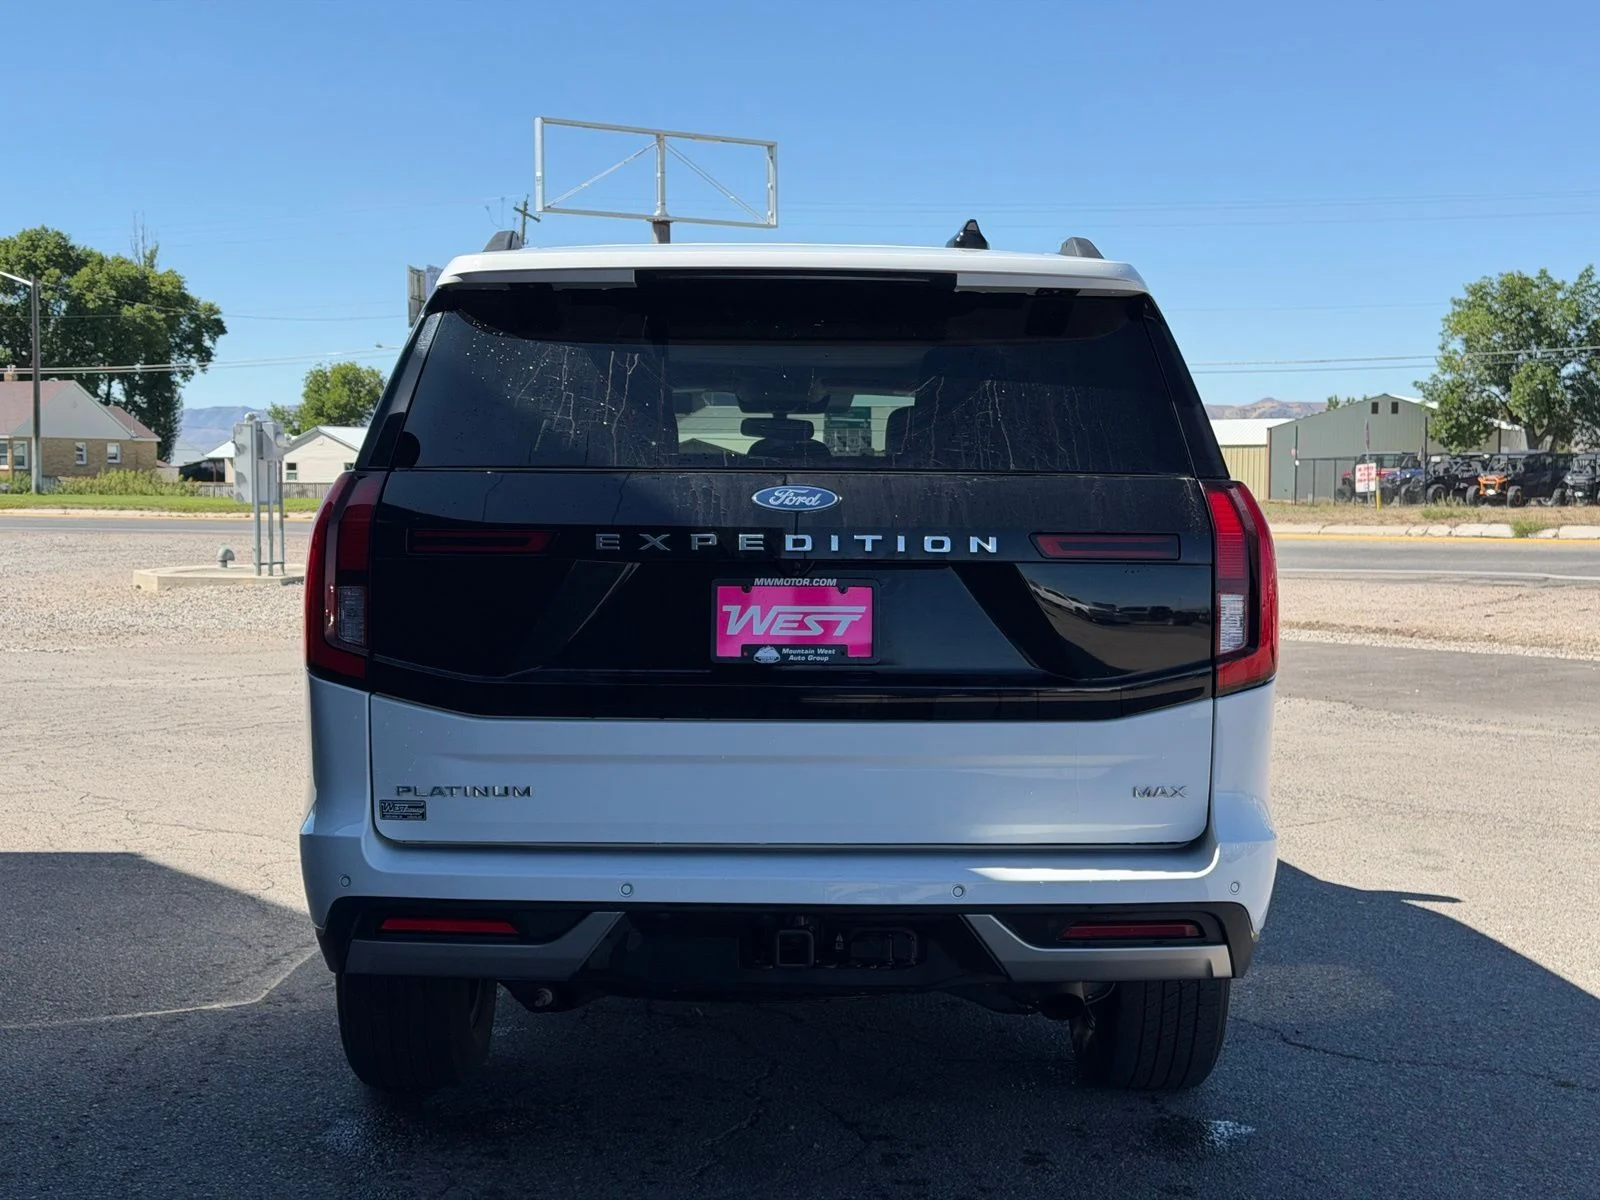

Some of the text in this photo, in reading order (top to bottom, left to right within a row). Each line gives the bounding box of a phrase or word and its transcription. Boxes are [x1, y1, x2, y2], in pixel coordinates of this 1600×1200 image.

[769, 489, 821, 506] Ford
[595, 534, 998, 553] EXPEDITION
[754, 578, 837, 586] MWMOTOR.COM
[722, 605, 867, 636] WEST
[396, 786, 533, 797] PLATINUM
[1132, 786, 1186, 798] MAX
